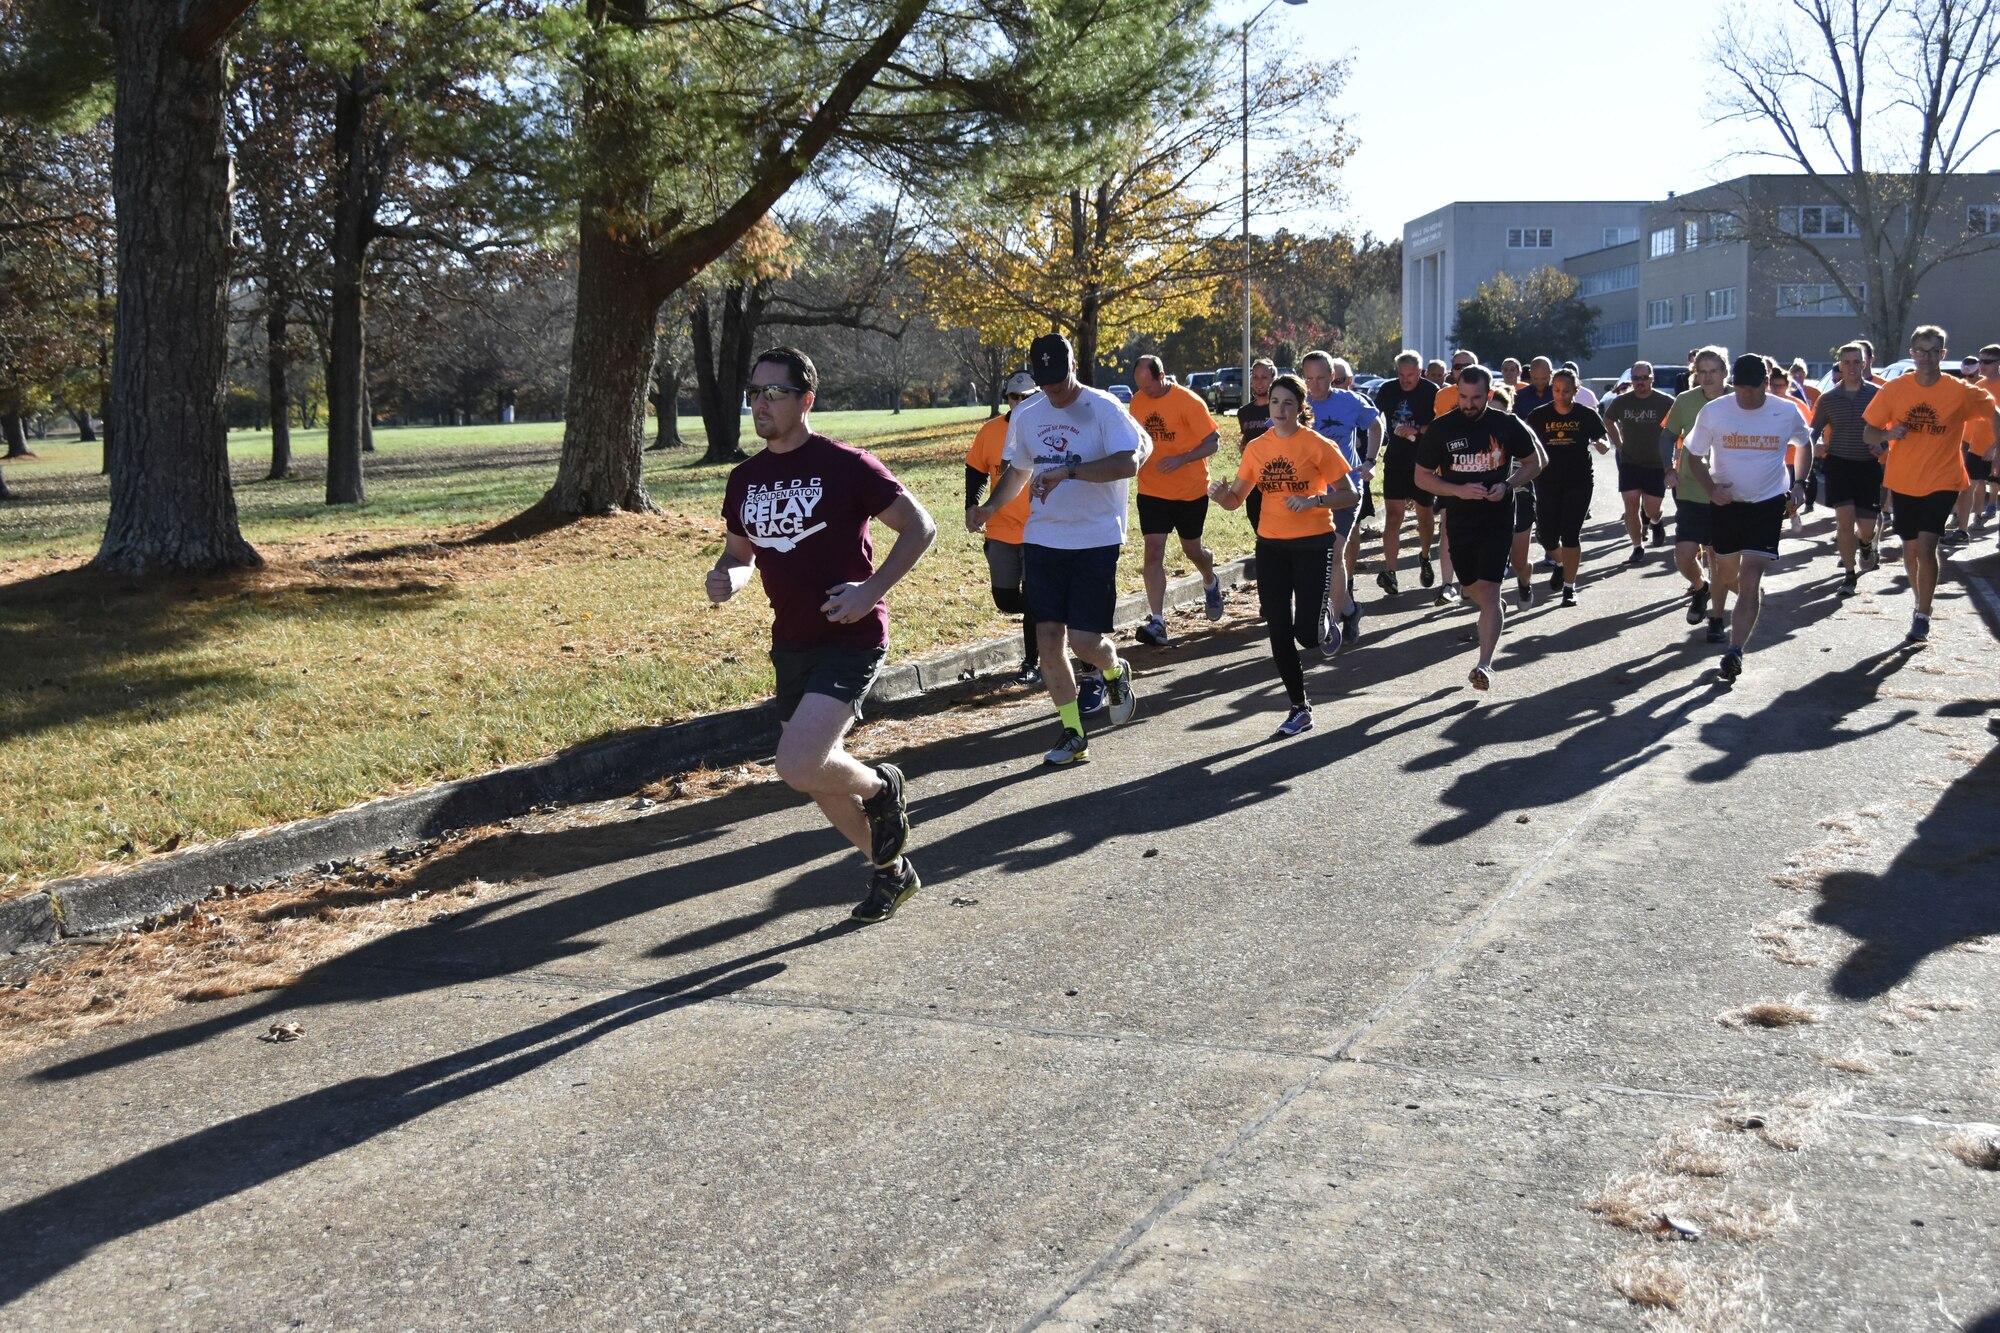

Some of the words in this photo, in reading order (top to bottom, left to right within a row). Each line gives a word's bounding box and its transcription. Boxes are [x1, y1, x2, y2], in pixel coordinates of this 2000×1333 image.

[1545, 421, 1580, 429] LEGACY
[1450, 440, 1465, 450] 2014
[1750, 435, 1761, 443] OF
[1762, 435, 1780, 444] THE
[1452, 453, 1491, 465] TOUGH
[1452, 464, 1492, 473] MUDDER
[759, 477, 822, 493] AEDC
[1286, 480, 1310, 492] TROT
[755, 490, 788, 503] GOLDEN
[788, 488, 821, 498] BATON
[744, 496, 822, 525] RELAY
[756, 516, 805, 538] RACE
